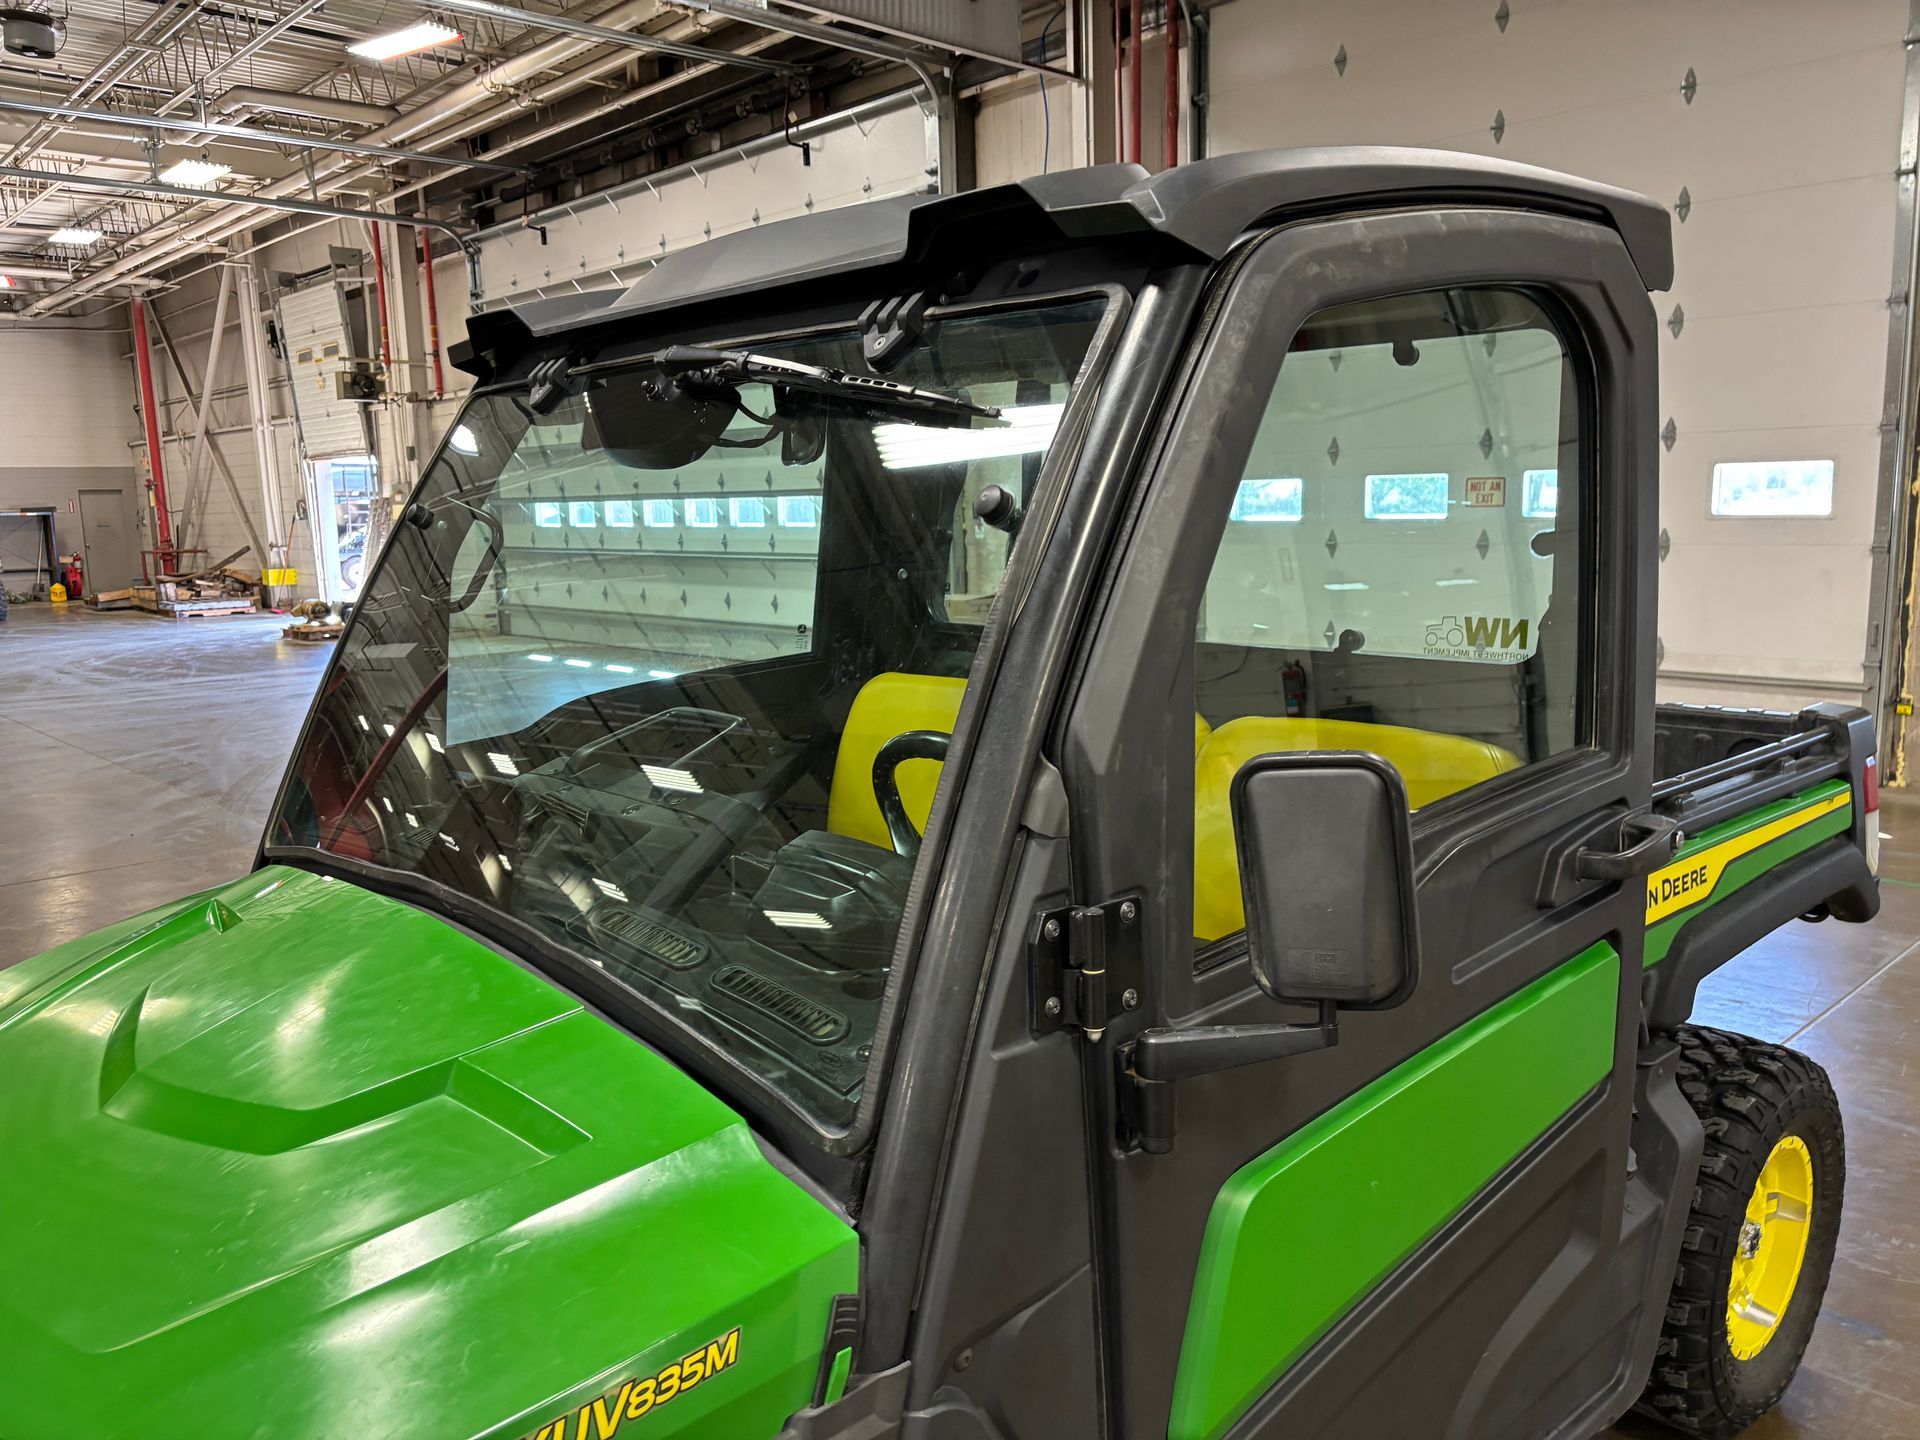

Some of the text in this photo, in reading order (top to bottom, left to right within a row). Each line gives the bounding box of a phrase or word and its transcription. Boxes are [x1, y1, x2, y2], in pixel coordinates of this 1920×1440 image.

[1470, 481, 1502, 491] NOT AN
[1476, 493, 1494, 503] EXIT
[1662, 865, 1707, 902] DEERE
[519, 1327, 742, 1440] UV835M
